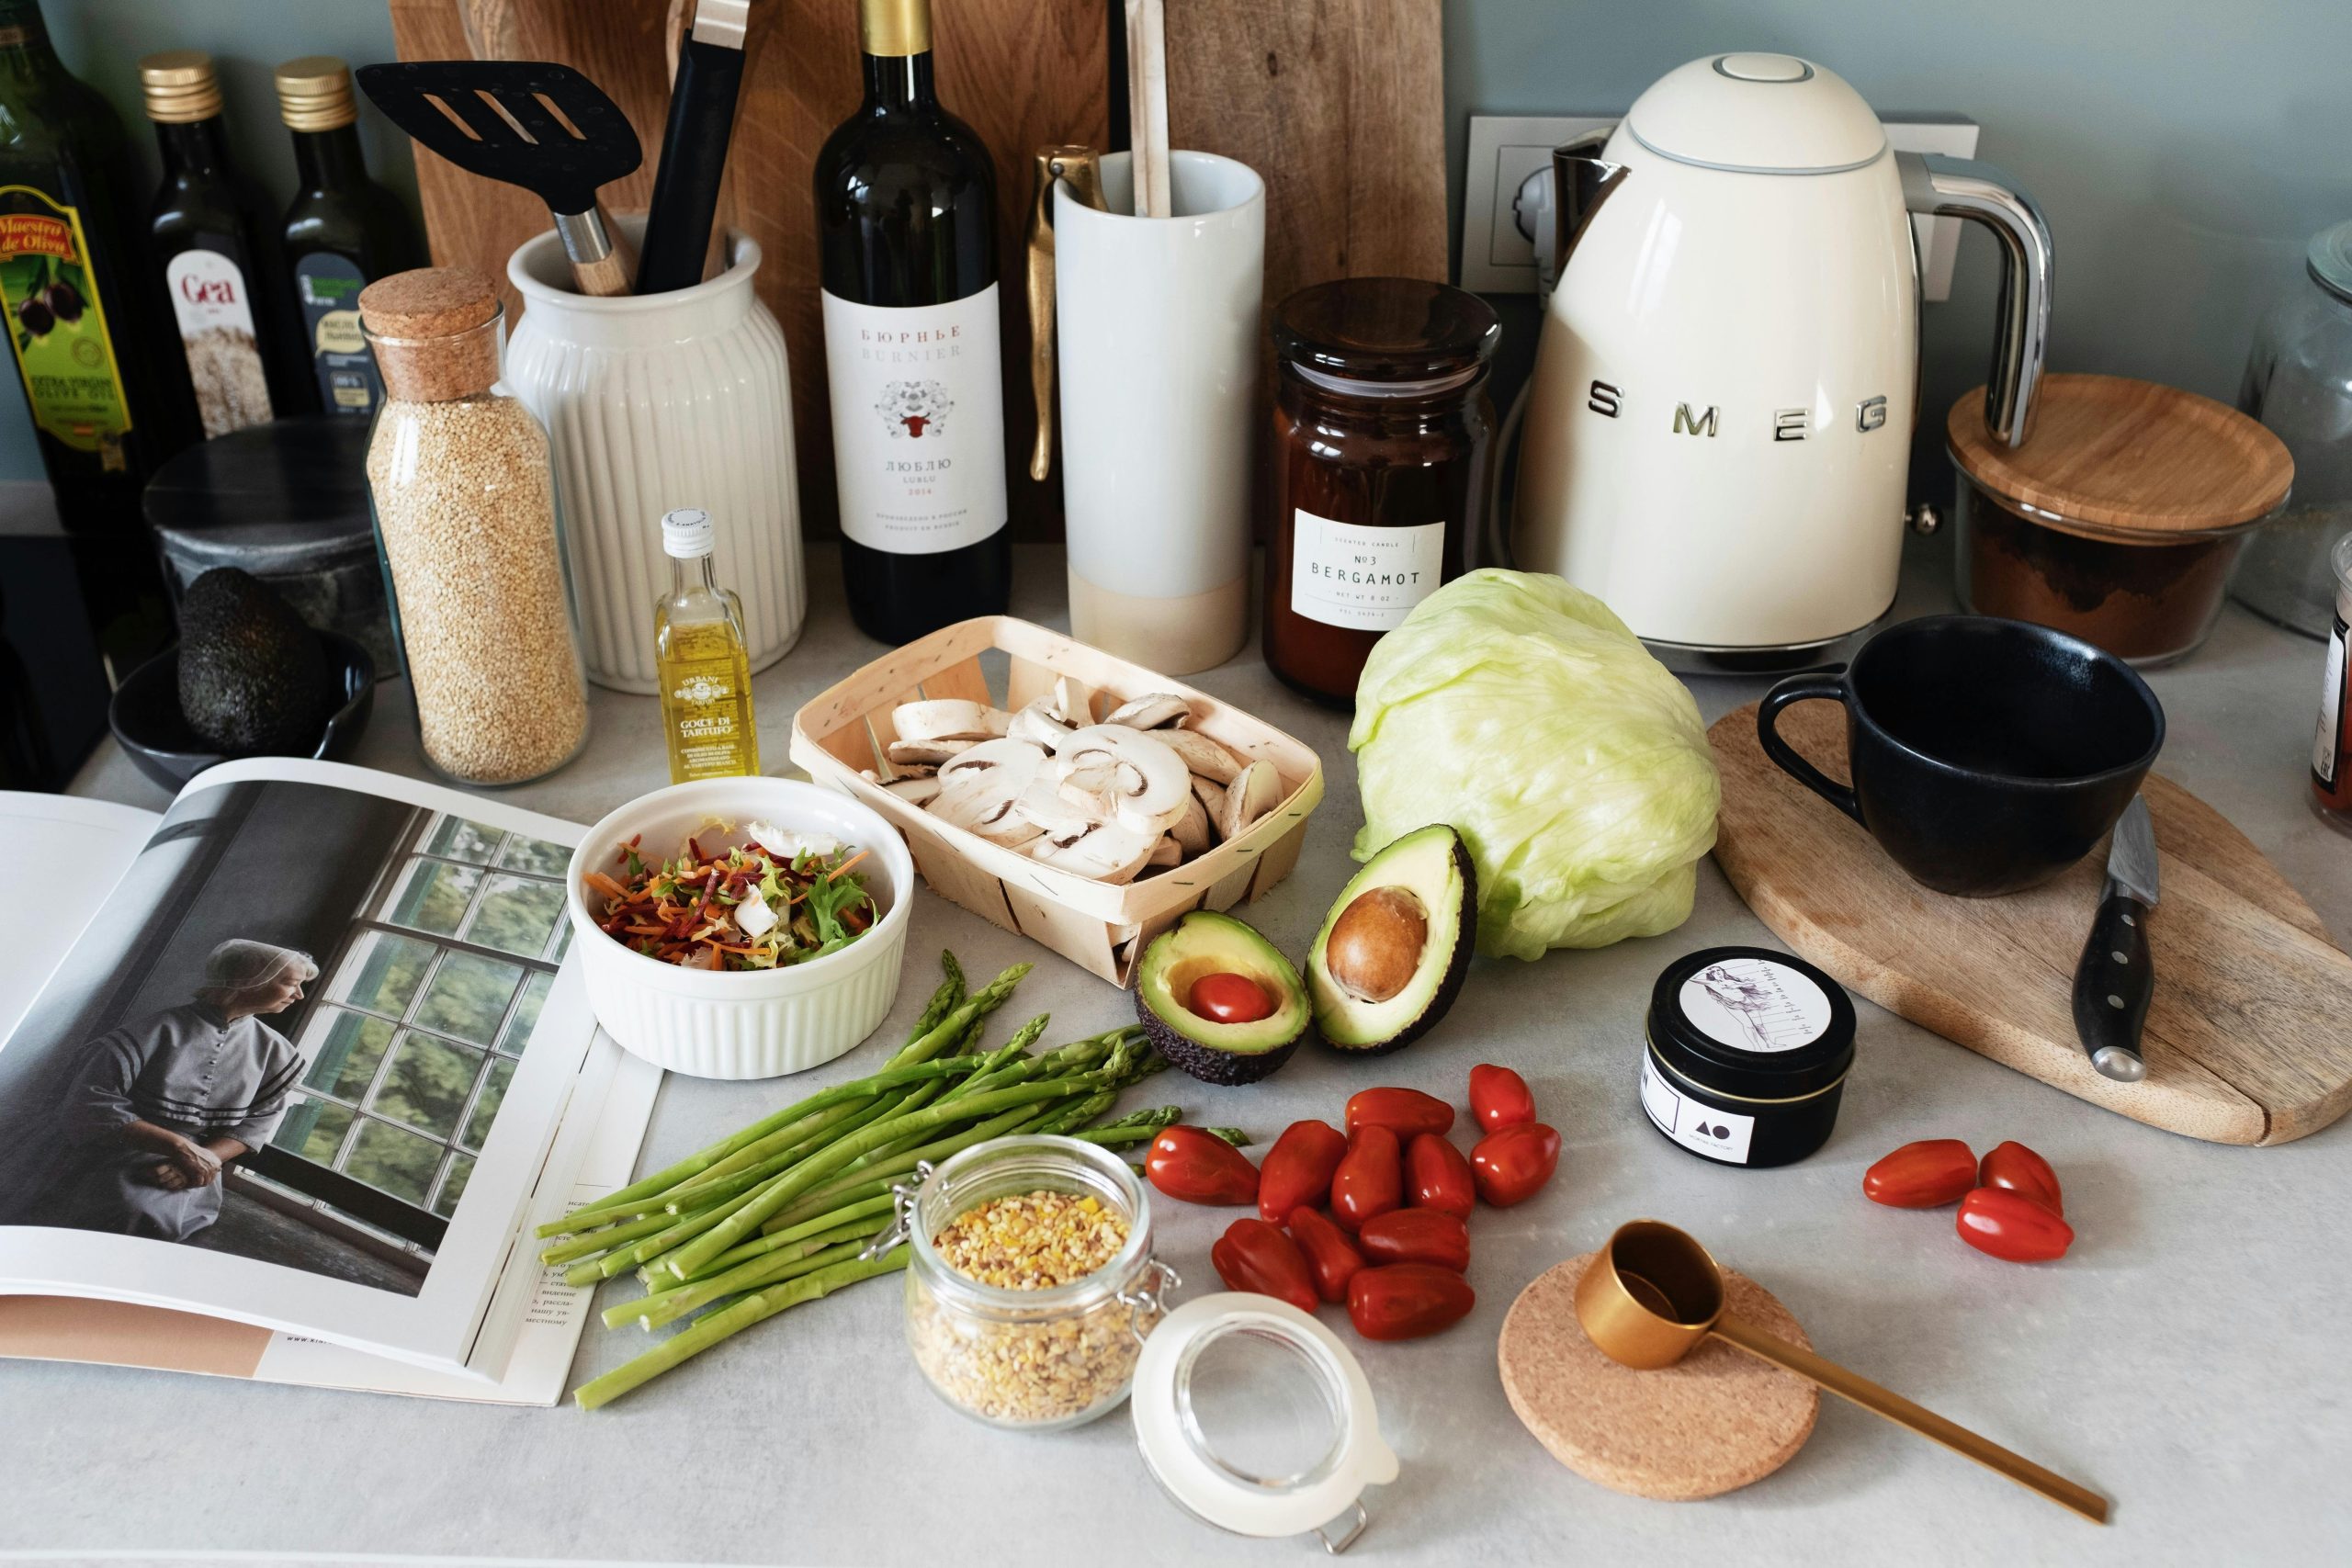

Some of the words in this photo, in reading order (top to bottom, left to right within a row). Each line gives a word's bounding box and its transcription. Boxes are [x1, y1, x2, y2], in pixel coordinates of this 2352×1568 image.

[2, 235, 18, 252] de
[23, 233, 65, 252] Oliva
[861, 325, 960, 344] БЮРНЬЕ
[862, 345, 960, 363] BURNIER
[1588, 378, 1887, 442] SMEG
[886, 458, 951, 472] ЛЮБЛЮ
[1335, 537, 1366, 546] SCENTED
[1370, 557, 1376, 566] 3
[1311, 561, 1419, 585] BERGAMOT
[682, 675, 719, 687] URBANI
[680, 717, 714, 729] GOCCE
[718, 716, 729, 726] DI
[681, 726, 732, 739] TARTUFO
[541, 1290, 577, 1298] видение
